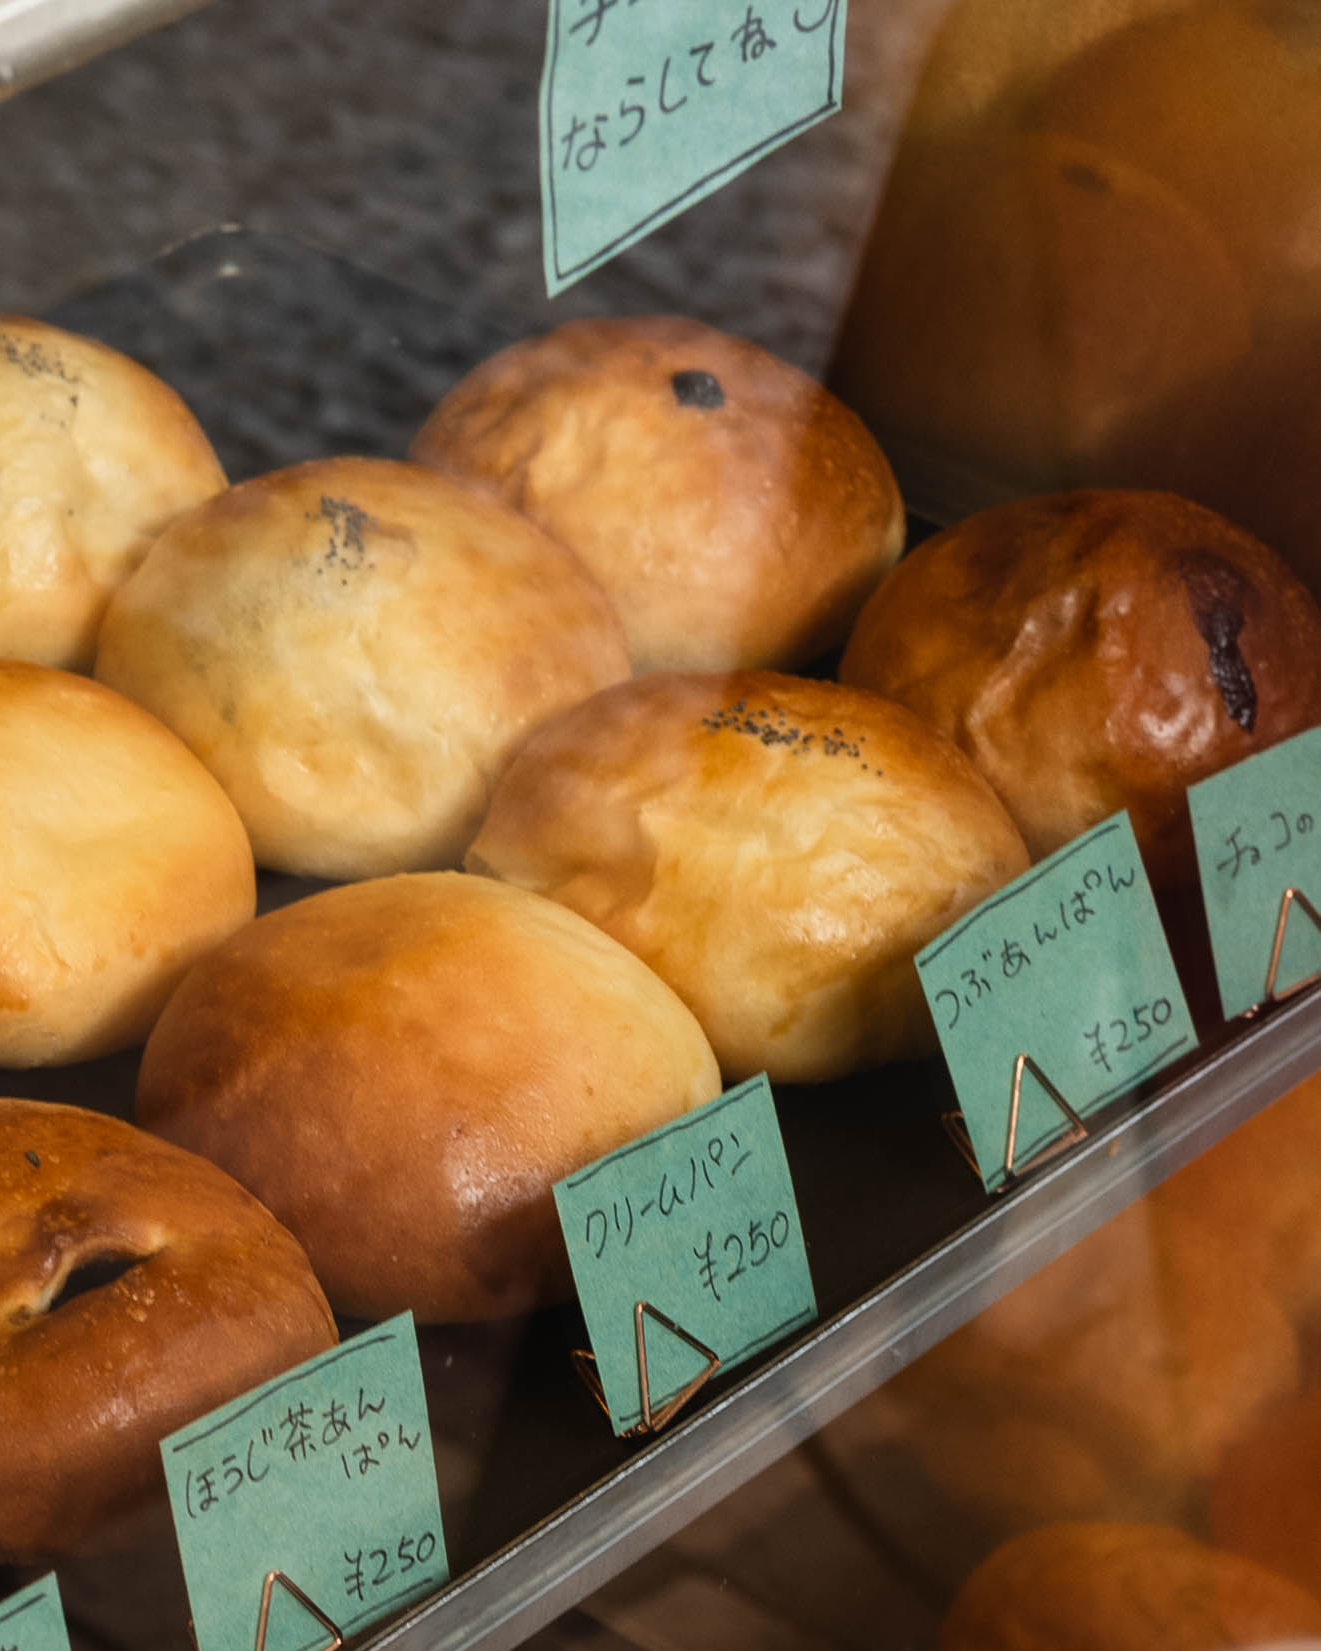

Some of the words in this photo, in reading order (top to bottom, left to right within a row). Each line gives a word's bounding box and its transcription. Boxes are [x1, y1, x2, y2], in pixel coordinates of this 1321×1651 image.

[935, 865, 1135, 1030] つぶあんぱん
[1084, 997, 1172, 1072] ¥250
[585, 1132, 752, 1259] クリームパン
[694, 1211, 789, 1301] ¥250
[185, 1387, 385, 1518] ほうじ茶あん
[341, 1424, 421, 1479] ぱん
[344, 1531, 436, 1601] ¥250
